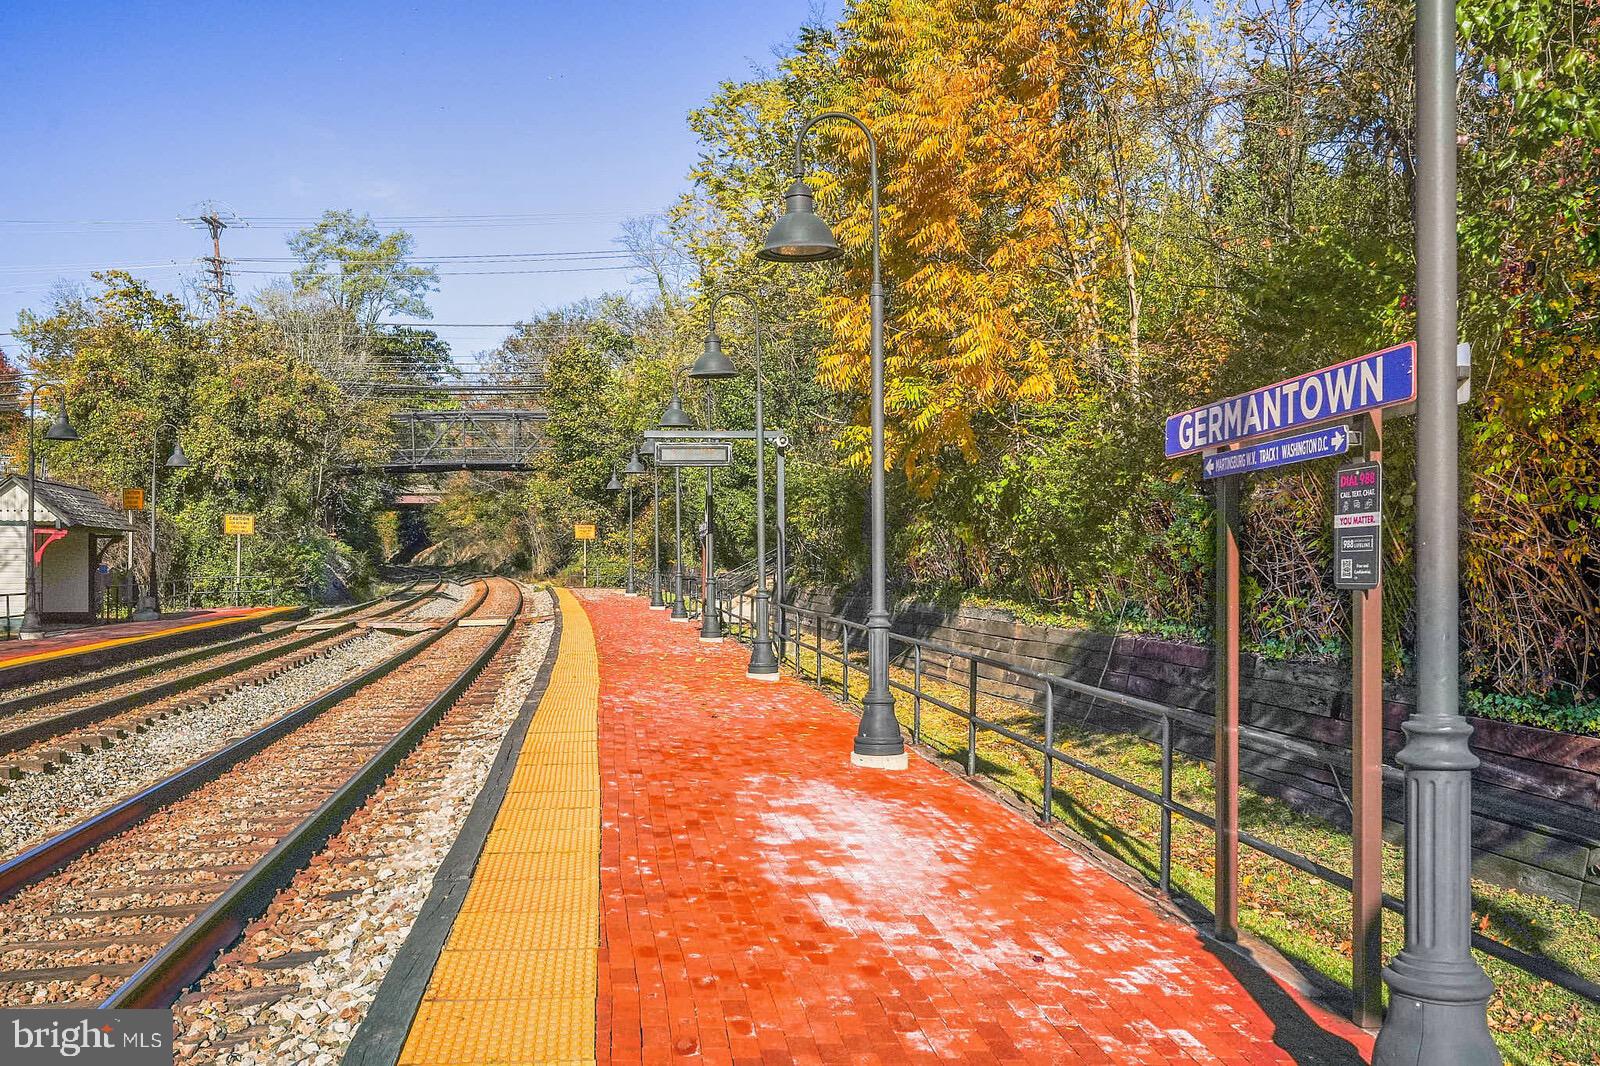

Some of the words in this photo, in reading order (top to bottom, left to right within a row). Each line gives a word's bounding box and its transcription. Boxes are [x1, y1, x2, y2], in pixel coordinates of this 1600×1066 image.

[1179, 356, 1384, 450] GERMANTOWN
[1215, 454, 1246, 472] MARTINSBURG
[1259, 447, 1276, 464] TRACK
[1281, 439, 1317, 459] WASHINGTON
[1318, 436, 1329, 452] D.C.
[1341, 474, 1358, 487] DIAL
[1360, 472, 1375, 484] 988
[1343, 539, 1353, 548] 988
